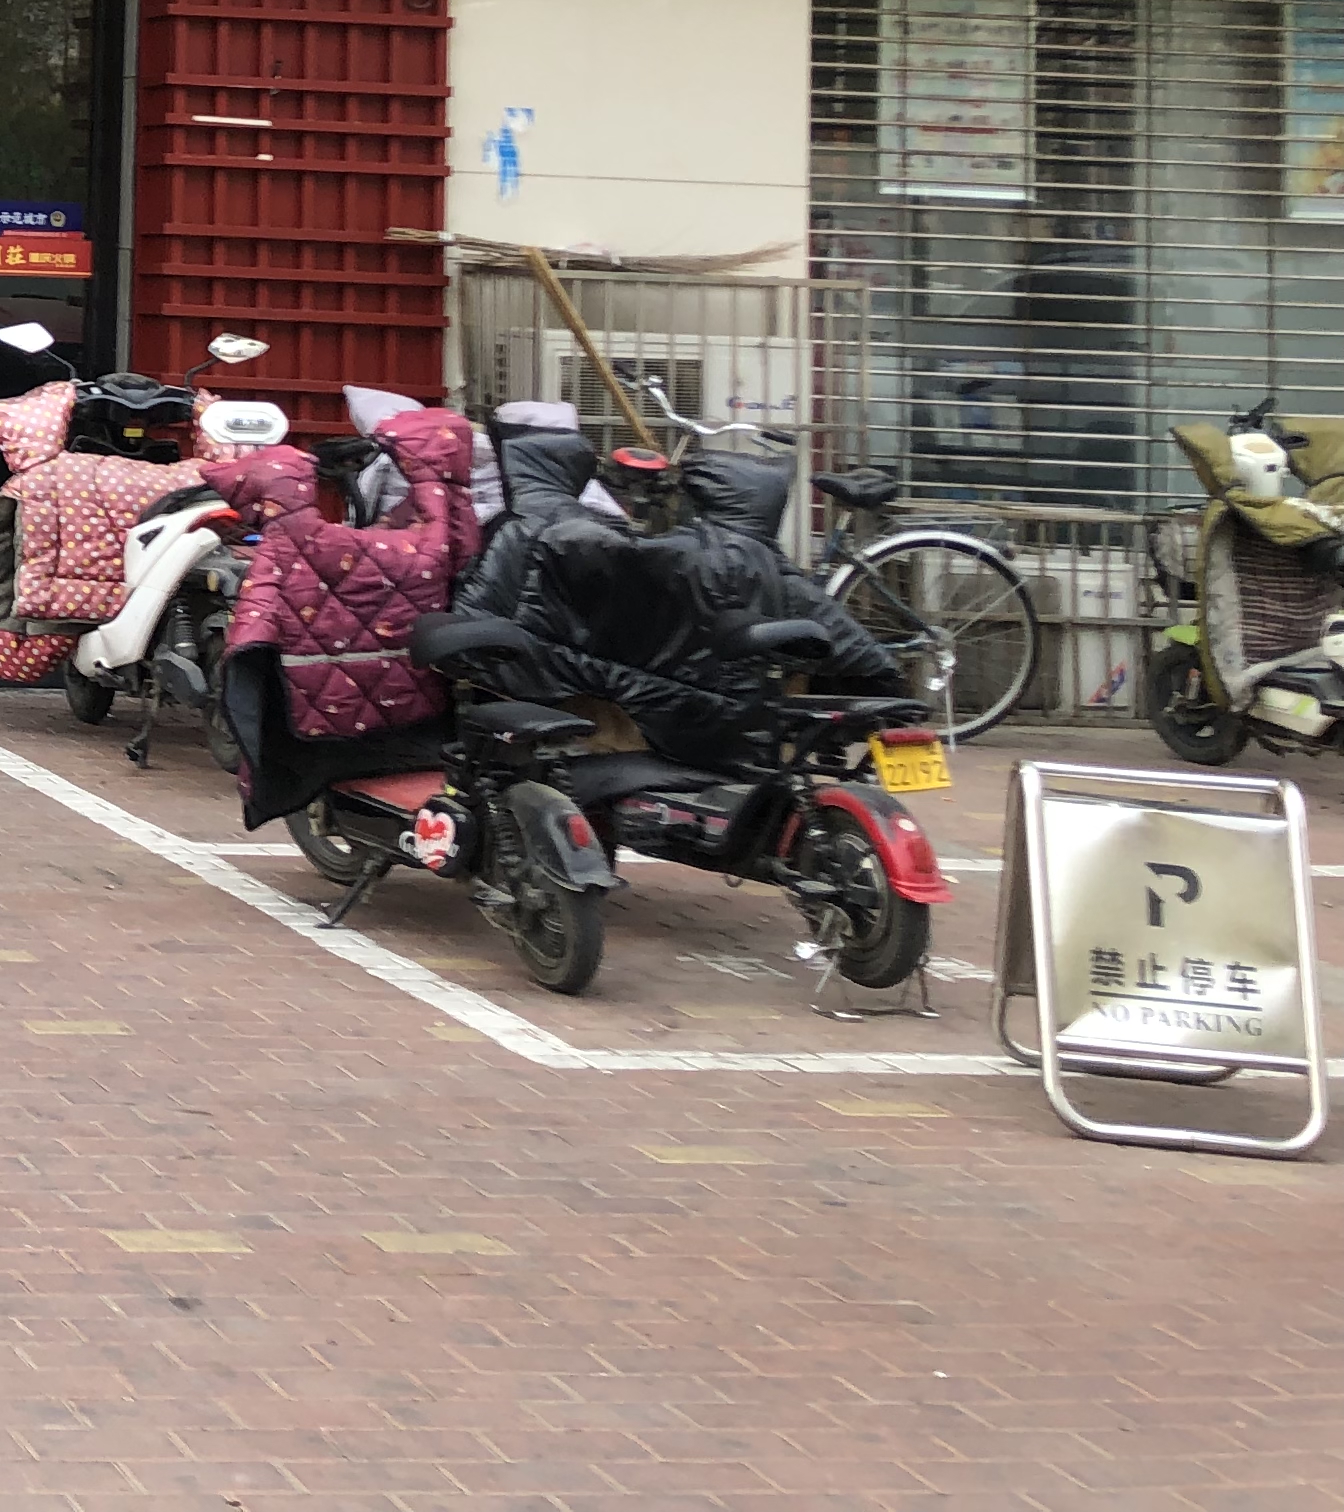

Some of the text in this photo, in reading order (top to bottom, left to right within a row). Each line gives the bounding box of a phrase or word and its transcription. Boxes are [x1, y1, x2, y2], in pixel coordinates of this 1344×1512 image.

[1089, 947, 1261, 1000] 禁止停车
[1092, 1001, 1263, 1037] NO PARKING
